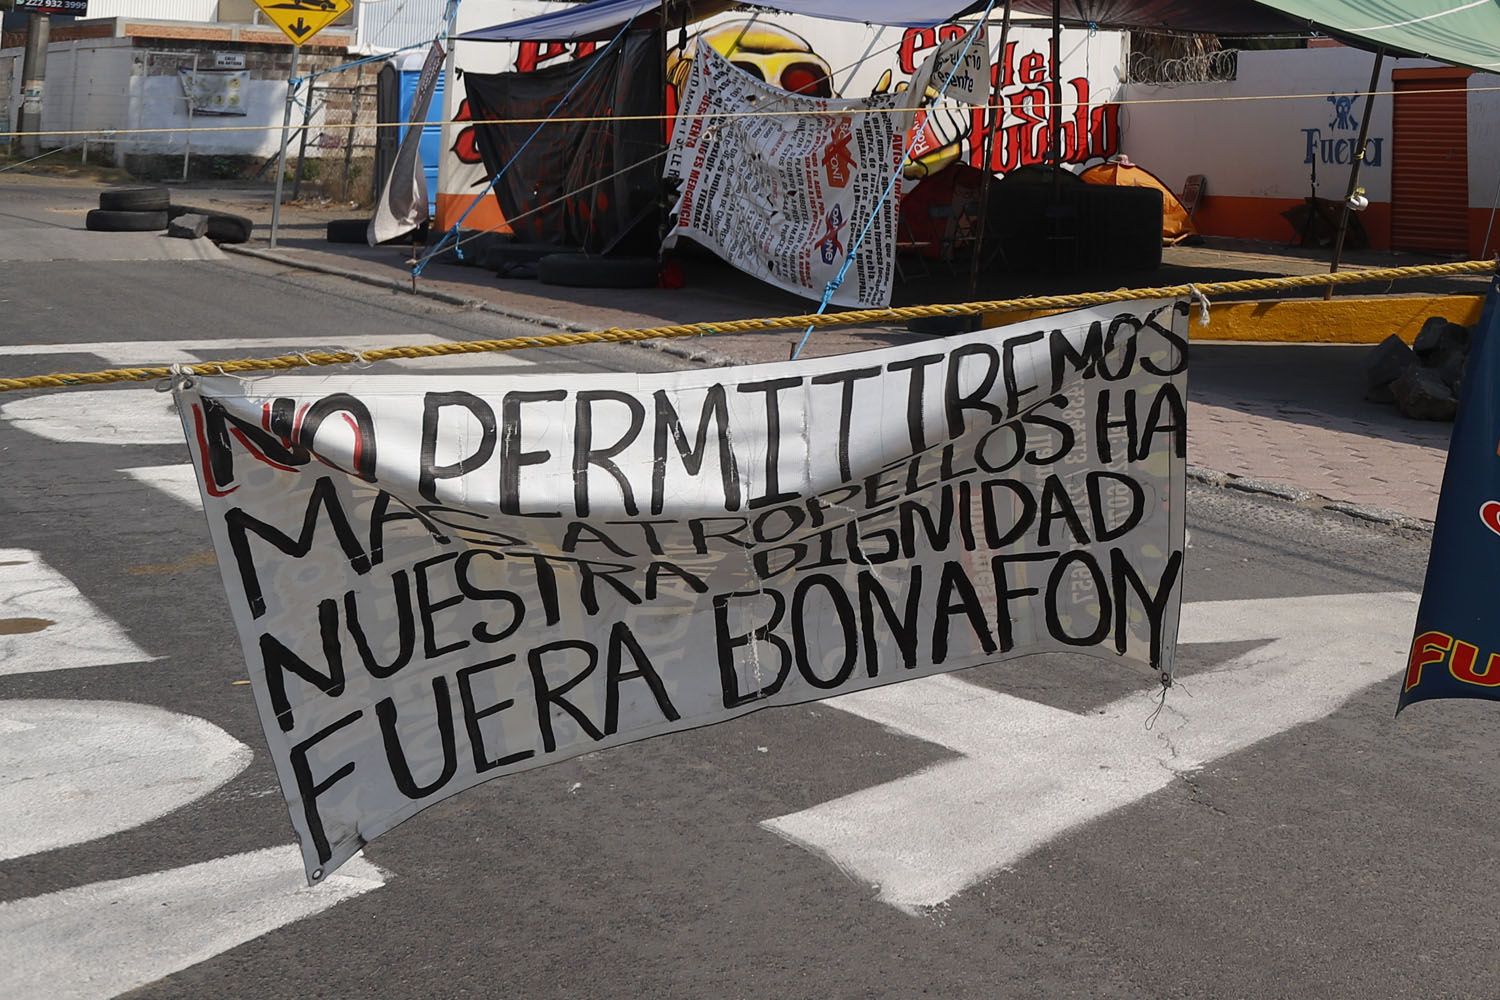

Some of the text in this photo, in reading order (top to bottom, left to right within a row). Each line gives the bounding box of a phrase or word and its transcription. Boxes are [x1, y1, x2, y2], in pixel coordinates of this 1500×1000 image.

[45, 0, 63, 8] 932
[65, 0, 87, 9] 3999
[193, 393, 378, 497] NO
[225, 476, 527, 619] MAS
[561, 394, 1075, 557] ATROPELLOS
[1095, 382, 1188, 463] HA
[259, 549, 709, 733] NUESTRA
[752, 470, 1146, 580] DIGNIDAD
[289, 620, 682, 865] FUERA
